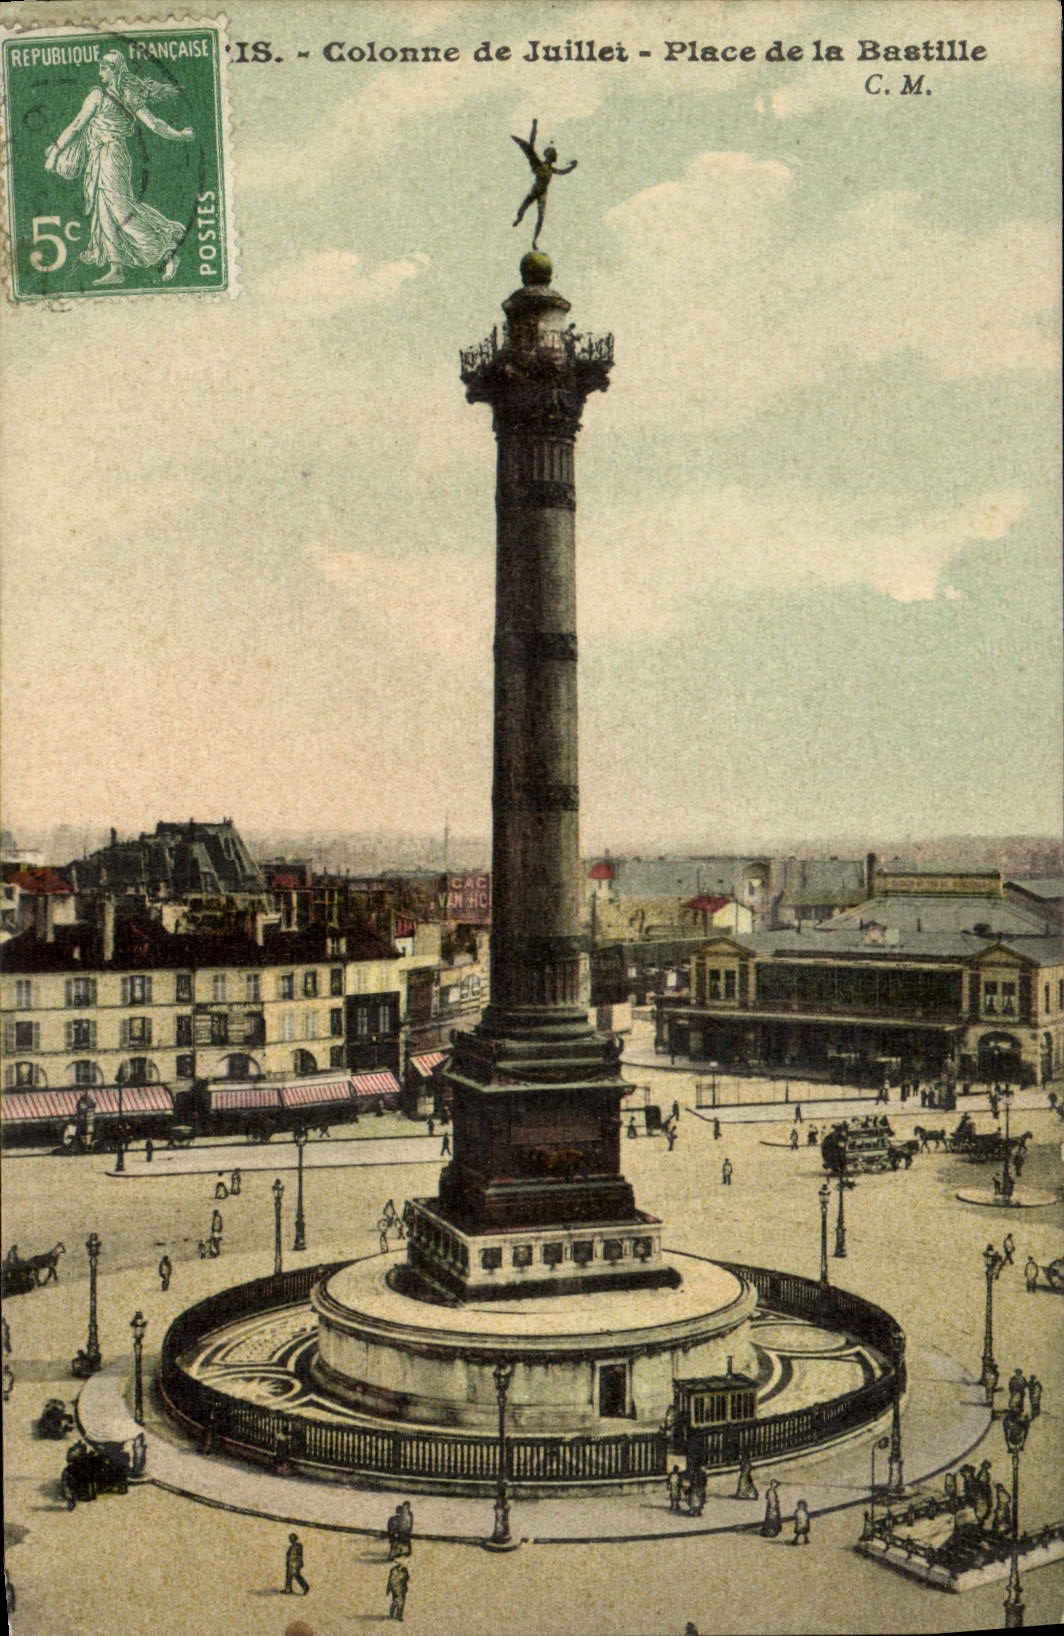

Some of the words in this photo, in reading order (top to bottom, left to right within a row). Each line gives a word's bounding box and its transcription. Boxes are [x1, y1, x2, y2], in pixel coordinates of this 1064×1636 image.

[11, 45, 100, 67] REPUBLIQUE
[128, 39, 209, 61] FRANÇAISE
[200, 190, 217, 276] POSTES
